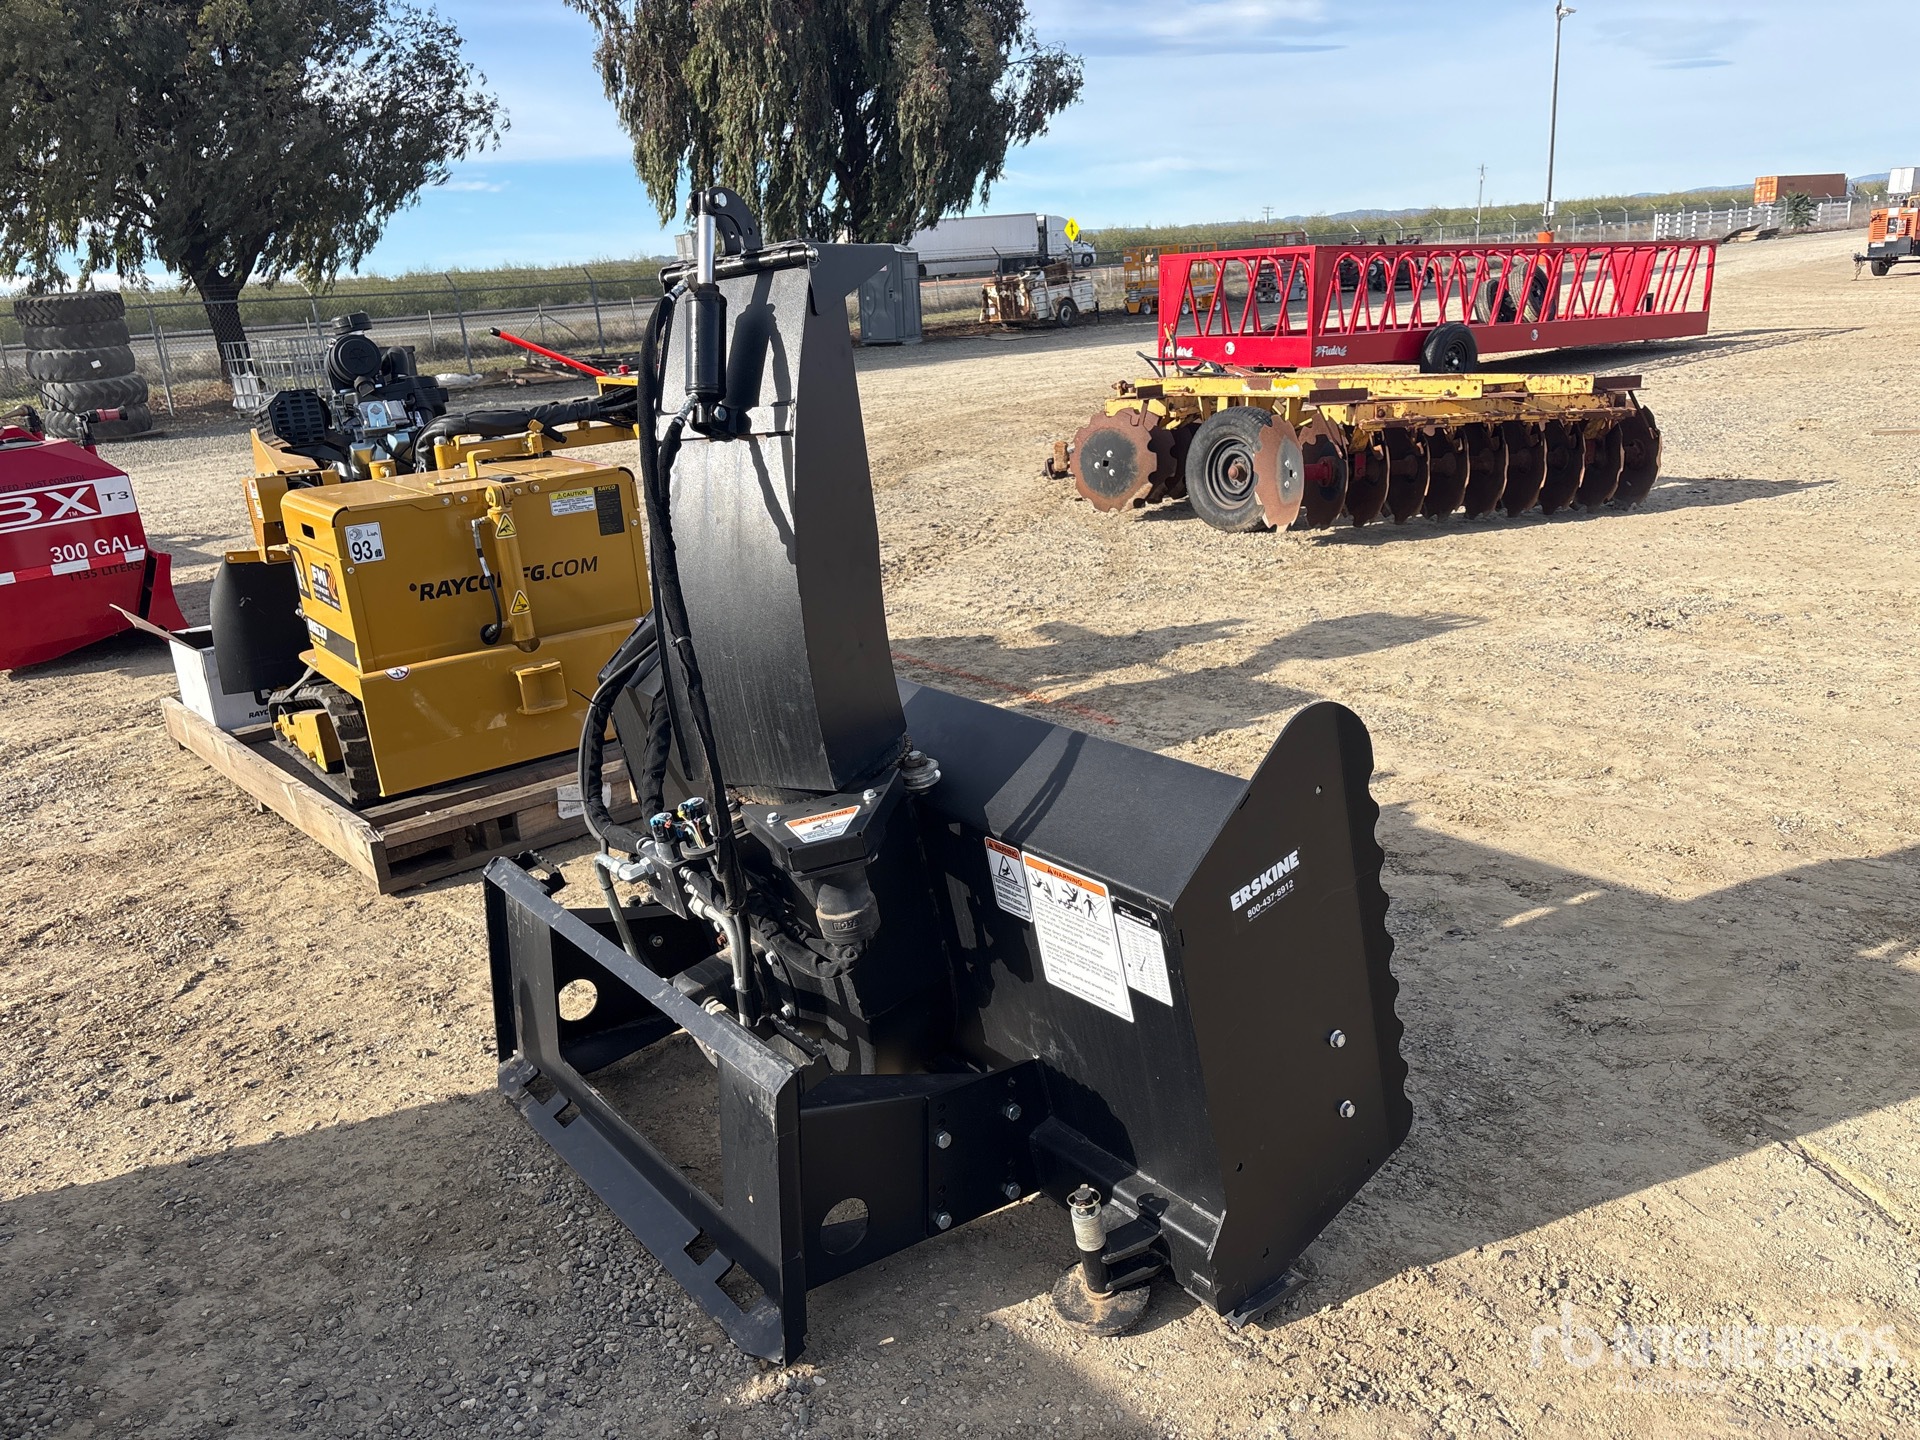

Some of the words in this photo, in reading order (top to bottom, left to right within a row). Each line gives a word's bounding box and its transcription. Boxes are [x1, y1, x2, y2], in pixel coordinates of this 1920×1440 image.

[25, 480, 47, 489] DUST
[49, 474, 86, 485] CONTROL
[101, 491, 129, 502] T3
[562, 489, 588, 498] CAUTION
[50, 542, 88, 563] 300
[94, 534, 145, 556] GAL.
[351, 540, 373, 561] 93
[102, 560, 142, 577] LITERS
[248, 709, 269, 719] RAYC
[808, 810, 848, 822] WARNING
[1053, 870, 1083, 887] WARNING
[1230, 849, 1300, 912] ERSKINE
[1247, 879, 1294, 918] 800-437-6912
